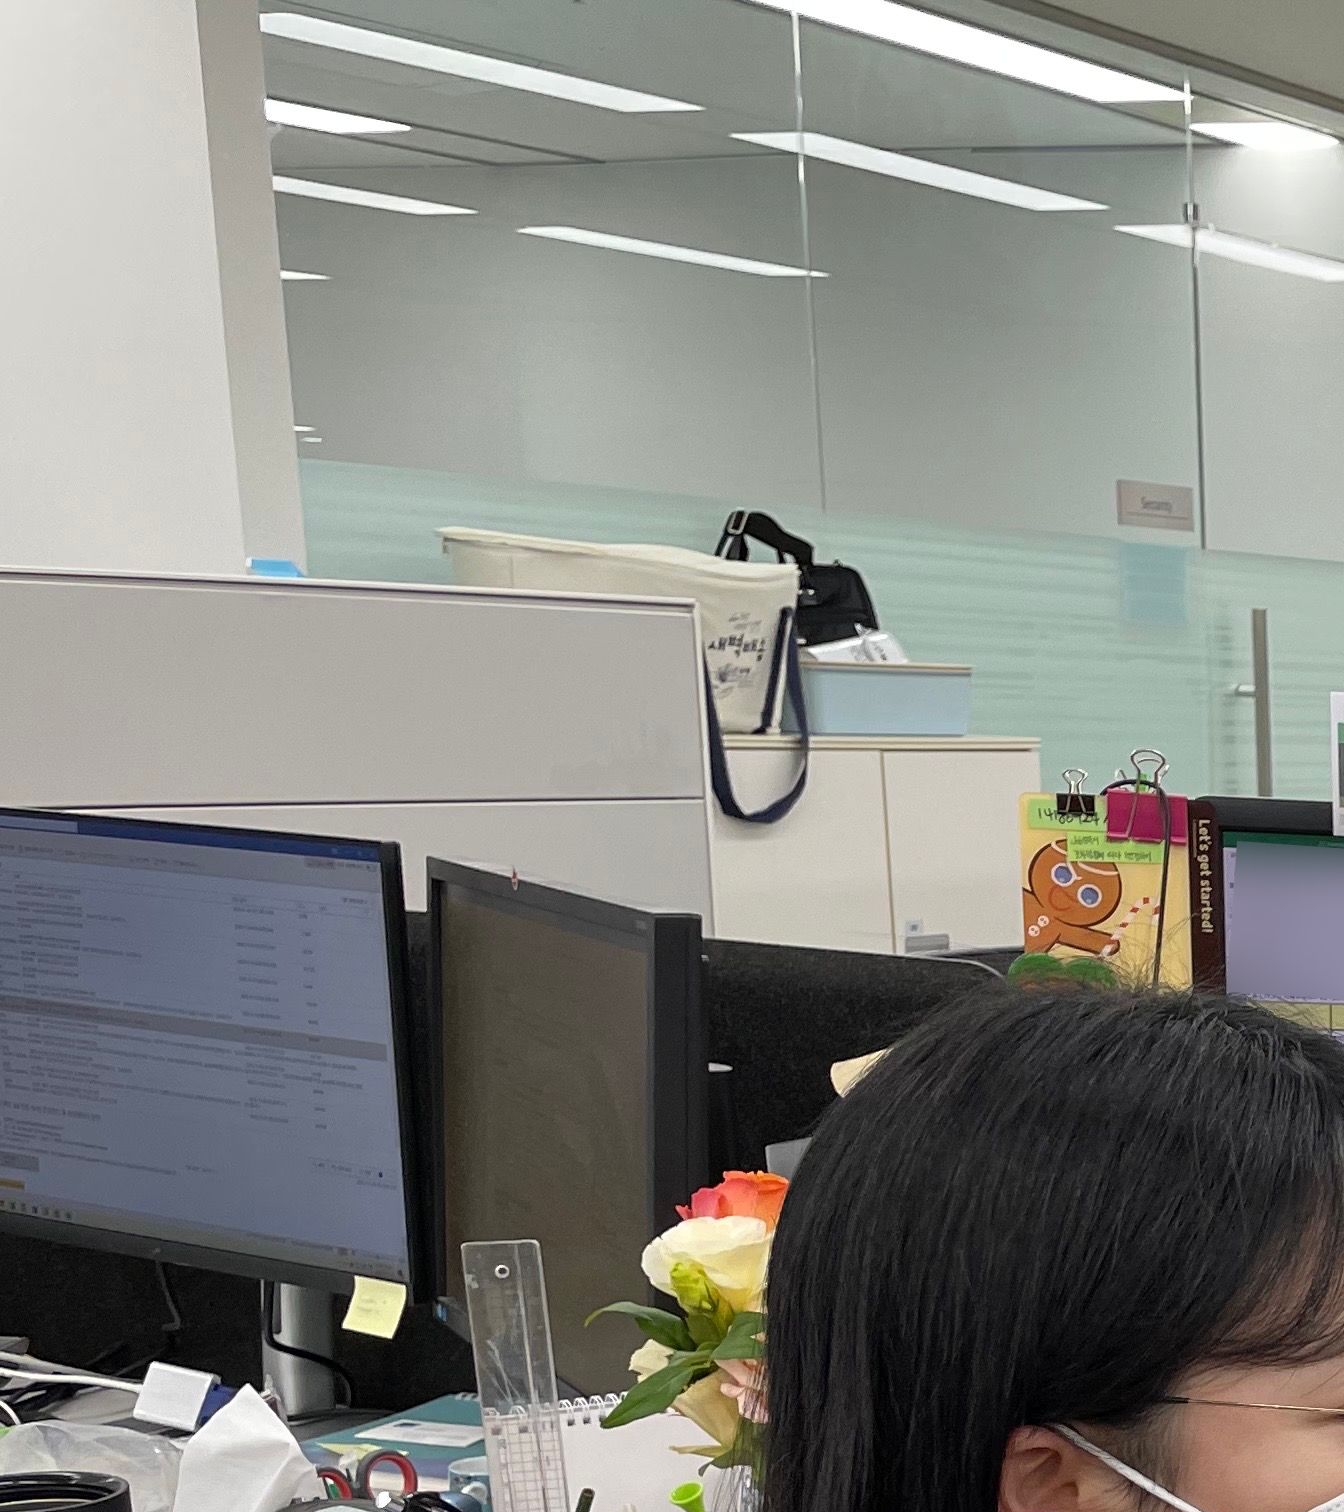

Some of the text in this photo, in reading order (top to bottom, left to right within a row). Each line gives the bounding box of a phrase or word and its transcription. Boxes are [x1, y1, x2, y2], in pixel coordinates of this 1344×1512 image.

[1197, 820, 1214, 933] Let's get started!
